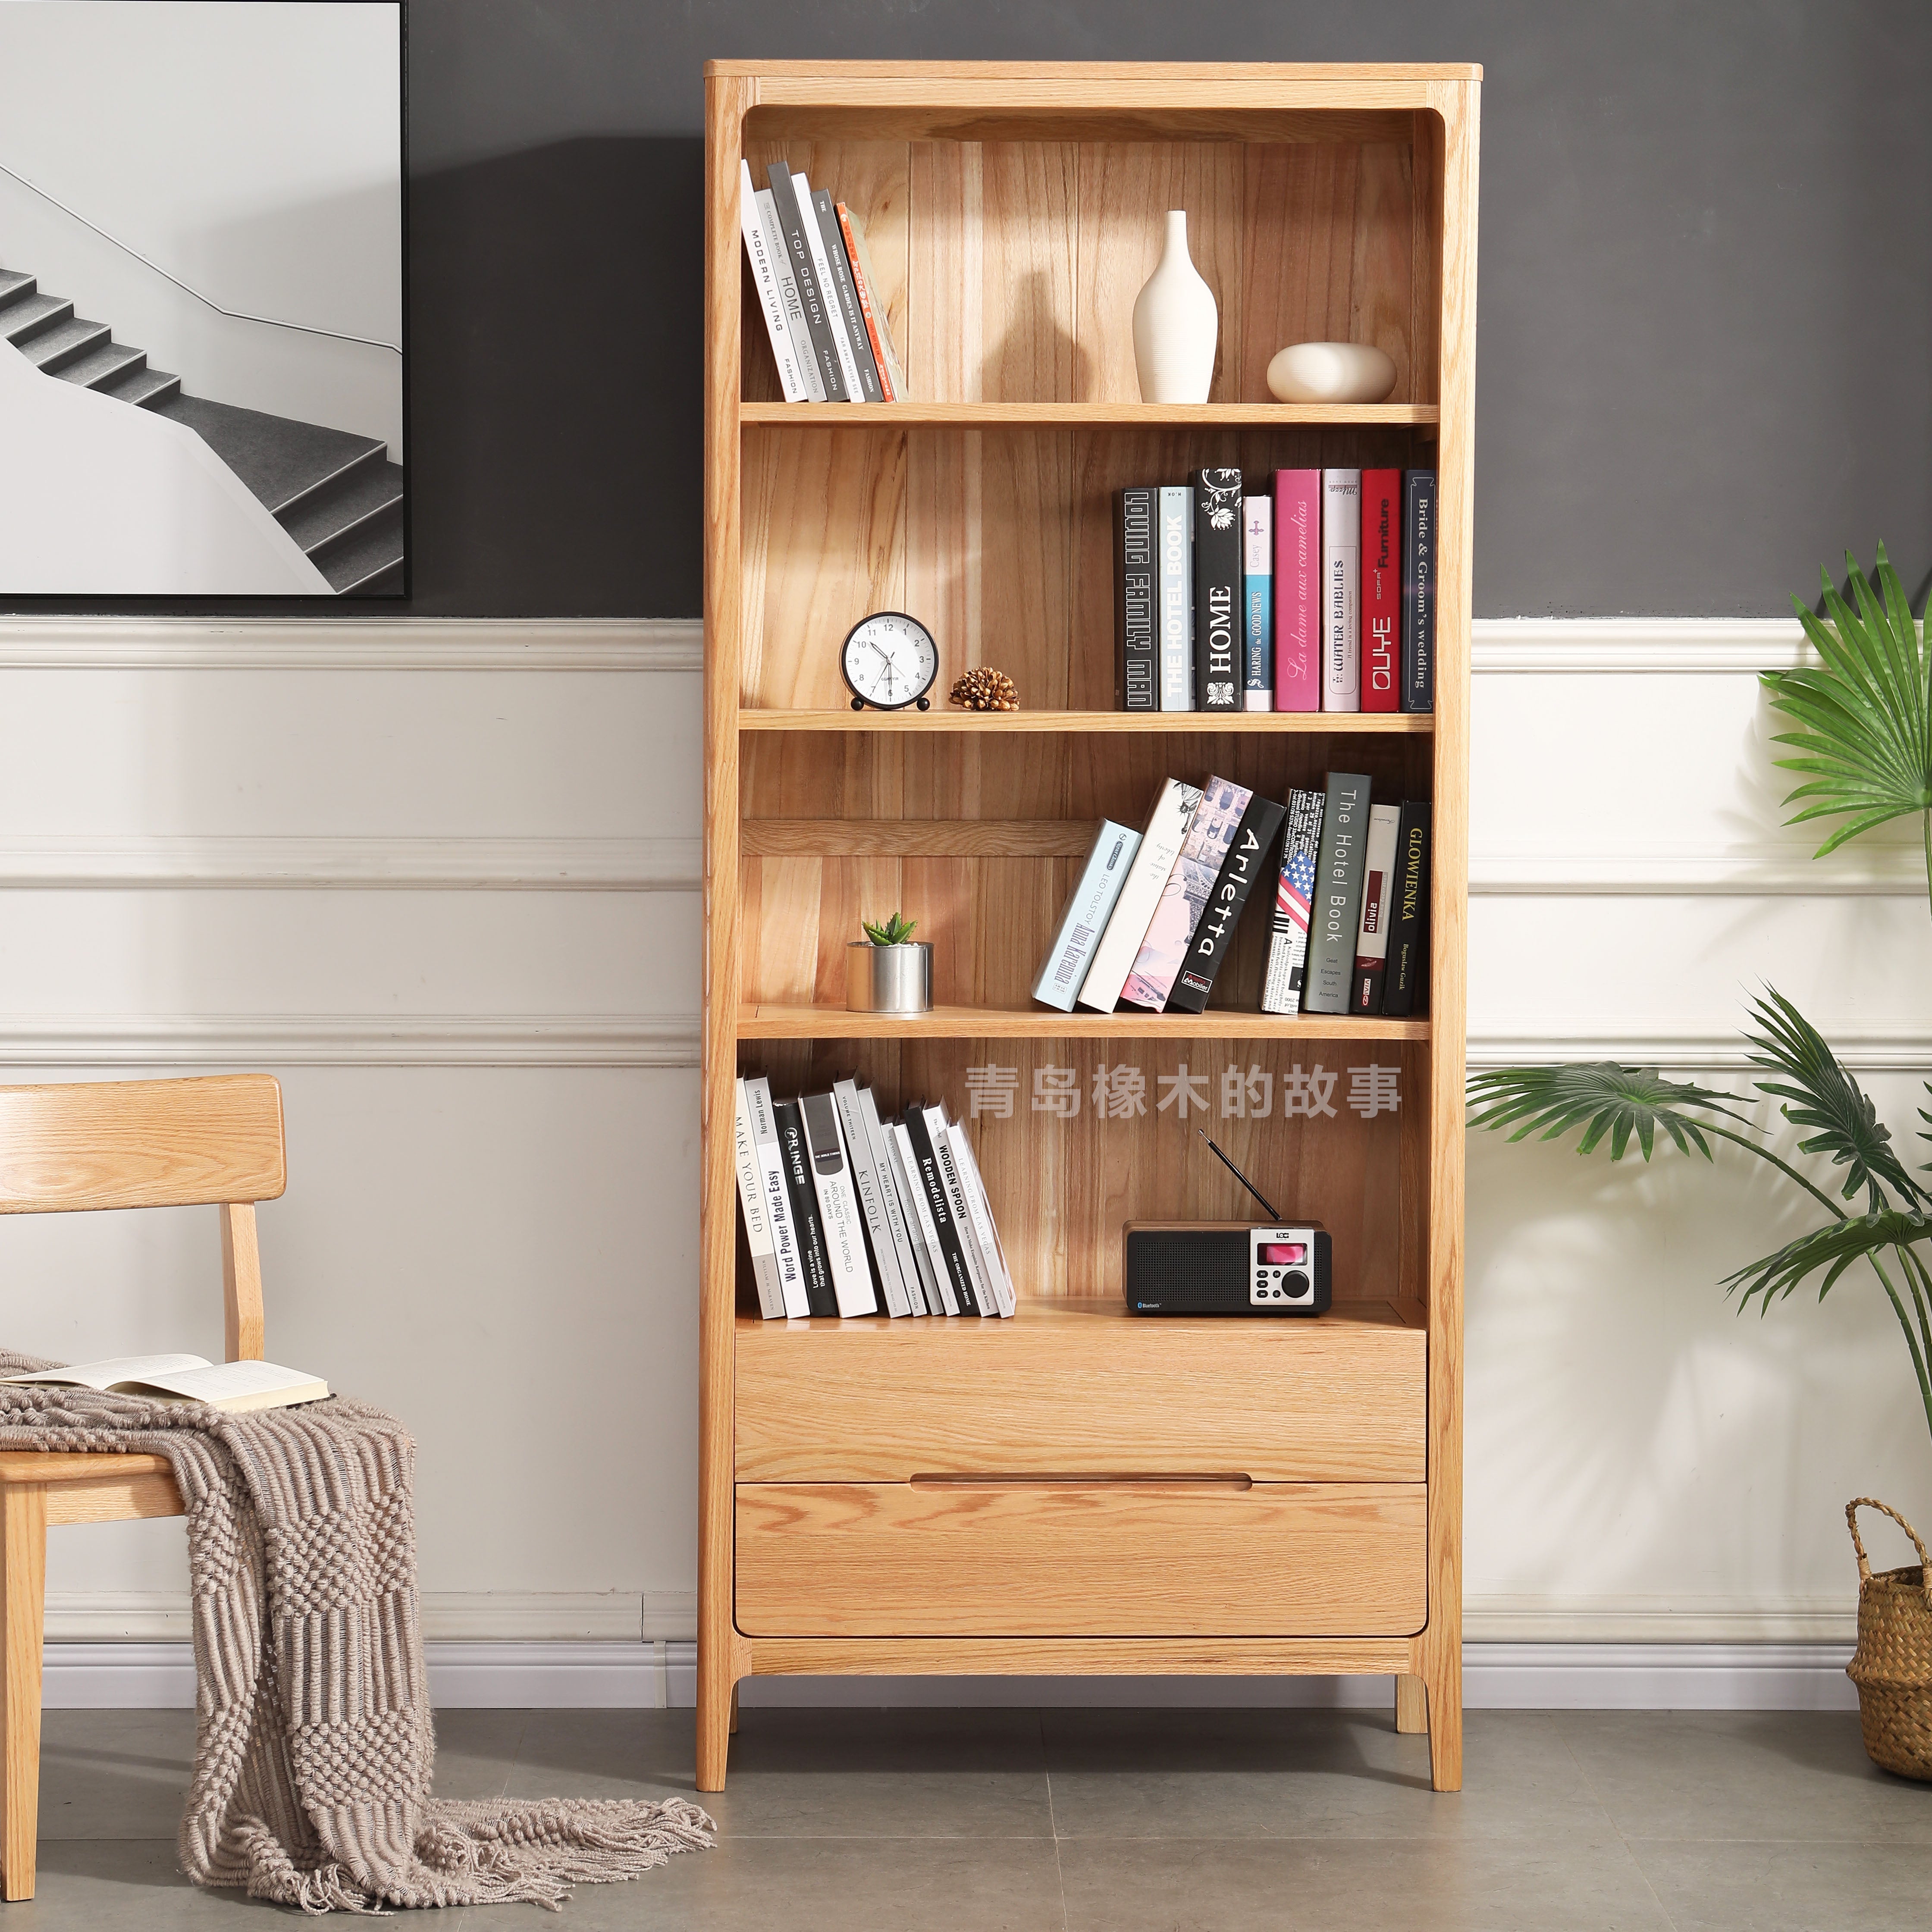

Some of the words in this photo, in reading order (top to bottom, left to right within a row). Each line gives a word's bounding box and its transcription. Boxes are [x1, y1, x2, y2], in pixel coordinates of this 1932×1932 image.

[766, 210, 779, 241] COMPLETE
[775, 242, 783, 259] BOOK
[752, 230, 770, 283] MODERN
[767, 289, 783, 331] LIVING
[792, 229, 805, 260] TOP
[801, 267, 822, 324] DESIGN
[818, 258, 826, 275] FEEL
[822, 278, 830, 288] NO
[826, 291, 838, 318] REGRET
[781, 276, 802, 321] HOME
[831, 244, 841, 267] WHOSE
[837, 267, 846, 282] ROSE
[842, 284, 853, 310] GARDEN
[852, 324, 864, 351] ANYWAY
[785, 359, 797, 393] FASHION
[800, 340, 819, 393] ORGANIZATION
[823, 350, 837, 391] FASHION
[847, 365, 855, 382] NEVER
[864, 369, 875, 393] FASHION
[1125, 492, 1150, 564] LOVING
[1291, 500, 1308, 566] camelias
[1378, 499, 1389, 568] Furniture
[1419, 498, 1428, 539] Bride
[1166, 514, 1182, 576] BOOK
[1250, 545, 1262, 568] Casey
[1418, 543, 1428, 556] &
[1298, 570, 1307, 600] aux
[1333, 560, 1344, 619] BABLIES
[1417, 561, 1429, 625] Groom's
[1126, 574, 1151, 650] FAMILY
[1167, 580, 1182, 649] HOTEL
[1210, 586, 1232, 674] HOME
[1290, 605, 1307, 648] dame
[1287, 652, 1307, 681] La
[1333, 625, 1344, 671] WATER
[1415, 629, 1428, 689] wedding
[1127, 660, 1152, 707] MAN
[1167, 655, 1182, 698] THE
[1338, 789, 1356, 824] The
[1150, 862, 1166, 871] statue
[1156, 843, 1175, 856] liberty
[1332, 834, 1352, 885] Hotel
[1099, 874, 1110, 889] LEO
[1198, 828, 1259, 957] Arletta
[1402, 828, 1423, 921] GLOWIENKA
[1084, 891, 1103, 925] TOLSTOY
[1326, 894, 1346, 943] Book
[1365, 902, 1377, 932] olivia
[1070, 922, 1095, 946] Anna
[1054, 944, 1087, 985] Karenina
[754, 1090, 763, 1108] Lewis
[736, 1117, 749, 1157] MAKE
[848, 1118, 856, 1140] THITEEN
[888, 1135, 898, 1164] SEASONAL
[784, 1127, 805, 1185] FRINGE
[879, 1163, 886, 1172] MY
[742, 1163, 757, 1202] YOUR
[768, 1171, 780, 1193] Easy
[829, 1181, 843, 1218] AROUND
[859, 1170, 882, 1234] KINFOLK
[882, 1175, 892, 1197] HEART
[922, 1157, 947, 1223] Remodelista
[939, 1145, 957, 1185] WOODEN
[951, 1187, 967, 1219] SPOON
[750, 1208, 762, 1233] BED
[772, 1195, 785, 1222] Made
[843, 1201, 851, 1224] CLASSIC
[891, 1209, 899, 1226] WITH
[907, 1156, 921, 1192] LEARNING
[917, 1193, 927, 1213] FROM
[928, 1229, 938, 1253] VEGAS
[959, 1158, 973, 1193] LEARNING
[970, 1195, 979, 1214] FROM
[975, 1217, 984, 1230] LAS
[981, 1232, 991, 1255] VEGAS
[778, 1226, 791, 1255] Power
[837, 1220, 847, 1239] THE
[904, 1199, 913, 1218] flower
[910, 1220, 922, 1252] arranging
[782, 1257, 796, 1283] Word
[816, 1257, 825, 1275] grows
[841, 1240, 853, 1273] WORLD
[910, 1286, 919, 1309] FASHION
[955, 1263, 966, 1291] ORGANIZED
[963, 1292, 971, 1306] HOME
